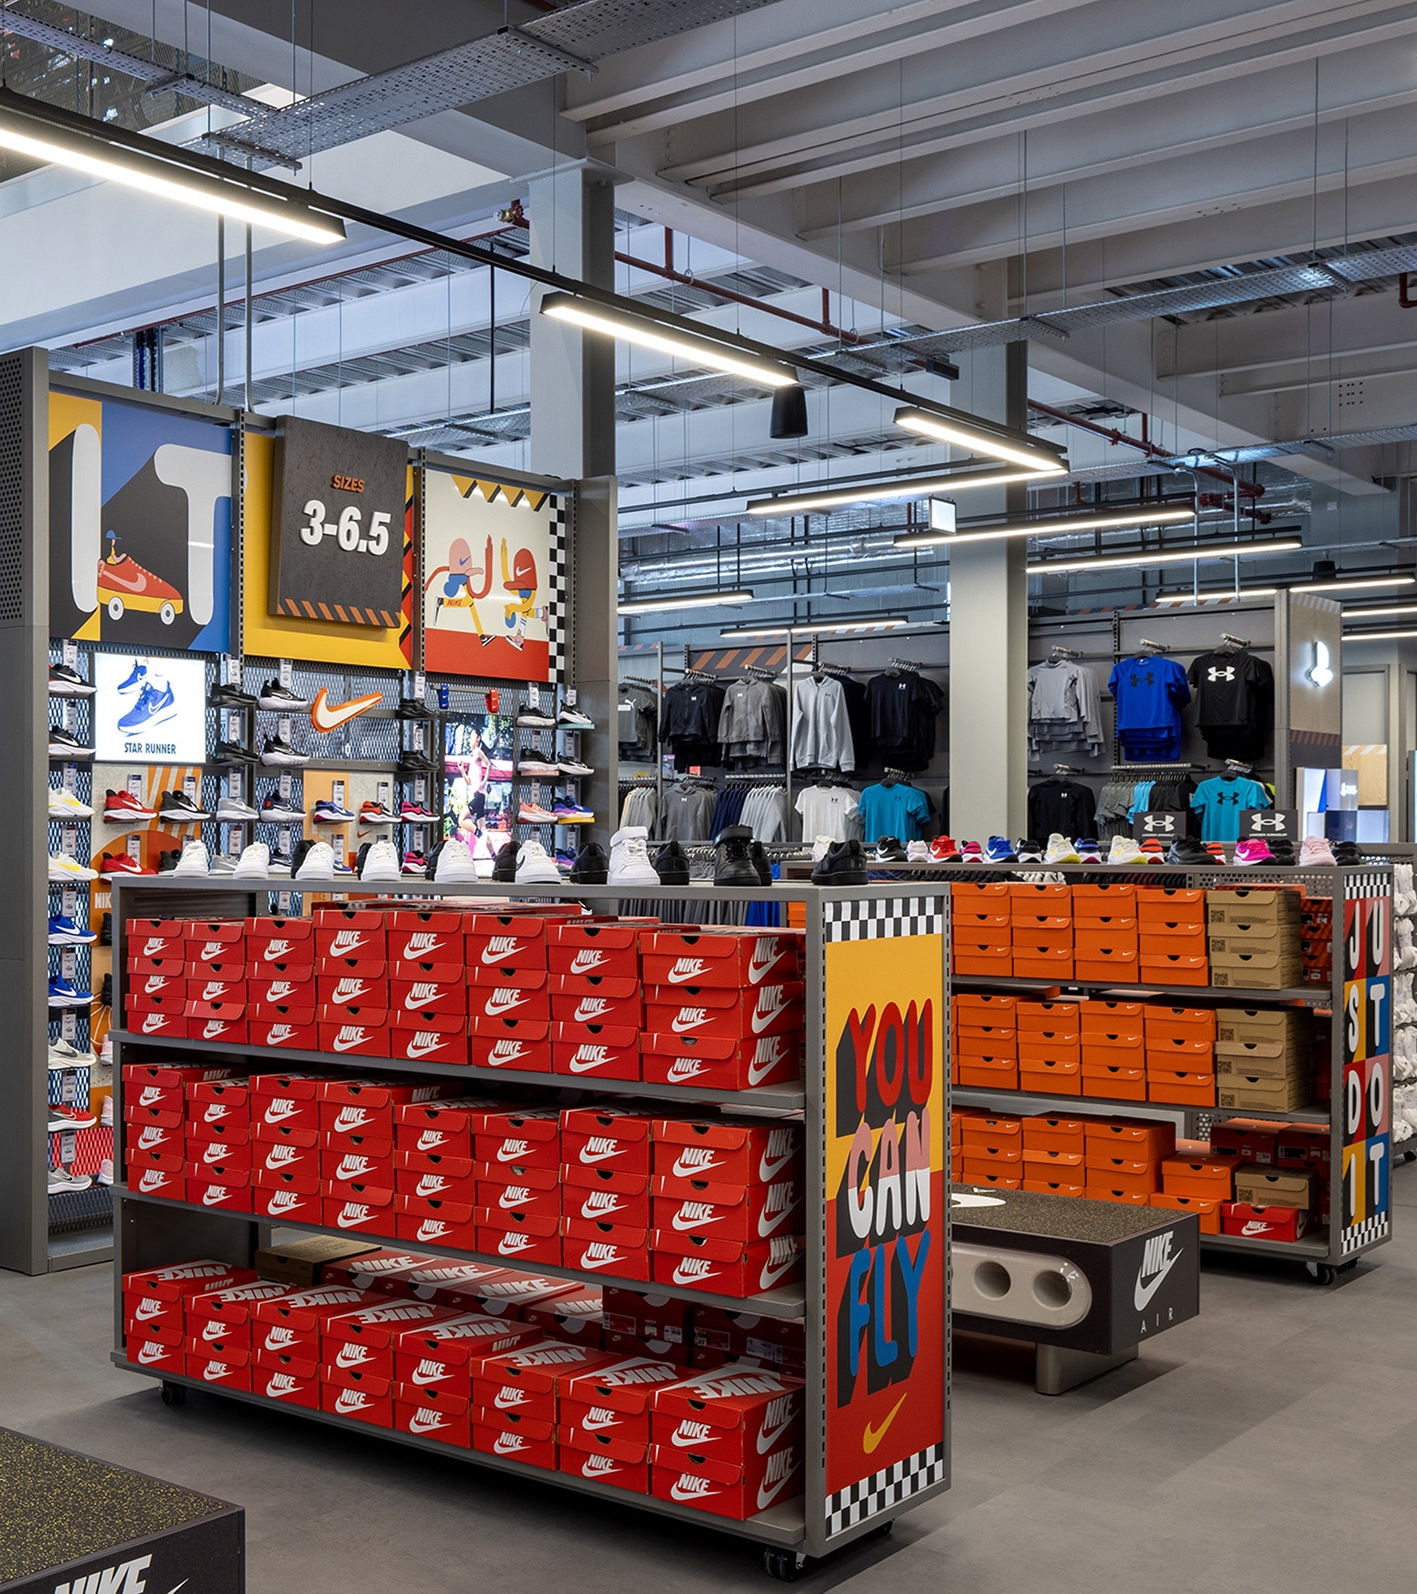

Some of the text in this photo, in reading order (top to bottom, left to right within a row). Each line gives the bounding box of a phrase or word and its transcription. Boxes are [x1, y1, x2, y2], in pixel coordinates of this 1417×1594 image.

[331, 474, 365, 494] SIZES
[299, 500, 391, 556] 3-6.5
[124, 742, 177, 755] STAR RUNNER
[95, 892, 112, 909] NIK
[147, 938, 165, 948] NIKE
[336, 931, 360, 945] NIKE
[410, 933, 437, 948] NIKE
[487, 937, 517, 952] NIKE
[205, 942, 222, 952] NIKE
[270, 940, 289, 953] NIKE
[754, 937, 779, 962] NIKE
[576, 951, 602, 964] NIKE
[676, 958, 703, 972] NIKE
[148, 975, 165, 985] NIKE
[206, 982, 223, 993] NIKE
[340, 979, 363, 994] NIKE
[270, 982, 291, 994] NIKE
[412, 984, 437, 999] NIKE
[491, 989, 520, 1004] NIKE
[758, 986, 784, 1011] NIKE
[580, 998, 607, 1011] NIKE
[146, 1013, 165, 1025] NIKE
[679, 1008, 707, 1021] NIKE
[206, 1021, 224, 1031] NIKE
[270, 1025, 291, 1037] NIKE
[341, 1026, 365, 1041] NIKE
[414, 1032, 440, 1047] NIKE
[495, 1040, 522, 1055] NIKE
[577, 1045, 608, 1060] NIKE
[755, 1037, 780, 1063] NIKE
[849, 998, 933, 1114] YOU
[674, 1058, 702, 1072] NIKE
[143, 1087, 161, 1098] NIKE
[208, 1105, 226, 1114] NIKE
[269, 1099, 294, 1114] NIKE
[339, 1107, 366, 1123] NIKE
[142, 1128, 163, 1141] NIKE
[421, 1131, 442, 1143] NIKE
[207, 1144, 227, 1156] NIKE
[503, 1139, 528, 1153] NIKE
[586, 1137, 617, 1154] NIKE
[765, 1128, 794, 1158] NIKE
[270, 1145, 295, 1160] NIKE
[680, 1148, 715, 1166] NIKE
[342, 1155, 369, 1170] NIKE
[143, 1172, 164, 1184] NIKE
[847, 1108, 931, 1239] CAN
[420, 1175, 444, 1188] NIKE
[206, 1186, 226, 1198] NIKE
[272, 1191, 298, 1206] NIKE
[505, 1186, 529, 1199] NIKE
[766, 1182, 794, 1213] NIKE
[588, 1192, 618, 1209] NIKE
[343, 1203, 369, 1219] NIKE
[680, 1201, 714, 1219] NIKE
[421, 1220, 445, 1233] NIKE
[1246, 1220, 1268, 1230] NIKE
[504, 1232, 529, 1246] NIKE
[588, 1242, 617, 1259] NIKE
[768, 1235, 798, 1266] NIKE
[1141, 1230, 1174, 1278] NIKE
[351, 1256, 413, 1271] NIKE
[681, 1257, 711, 1275] NIKE
[158, 1266, 227, 1281] NIKE
[411, 1265, 479, 1281] NIKE
[220, 1287, 286, 1302] NIKE
[479, 1279, 550, 1296] NIKE
[139, 1298, 161, 1313] NIKE
[288, 1292, 362, 1308] NIKE
[555, 1299, 602, 1314] NIK
[849, 1228, 931, 1378] FLY
[359, 1306, 434, 1324] NIKE
[206, 1321, 226, 1333] NIKE
[433, 1321, 510, 1339] NIKE
[269, 1327, 294, 1343] NIKE
[143, 1341, 165, 1357] NIKE
[340, 1343, 368, 1360] NIKE
[512, 1348, 587, 1366] NIKE
[207, 1361, 227, 1373] NIKE
[416, 1360, 445, 1377] NIKE
[270, 1373, 295, 1388] NIKE
[602, 1366, 678, 1386] NIKE
[499, 1386, 525, 1401] NIKE
[693, 1376, 786, 1399] NIKE
[340, 1389, 366, 1404] NIKE
[415, 1408, 443, 1425] NIKE
[587, 1407, 615, 1423] NIKE
[763, 1394, 794, 1427] NIKE
[678, 1420, 712, 1438] NIKE
[498, 1432, 524, 1447] NIKE
[587, 1454, 615, 1469] NIKE
[764, 1447, 794, 1481] NIKE
[677, 1474, 710, 1492] NIKE
